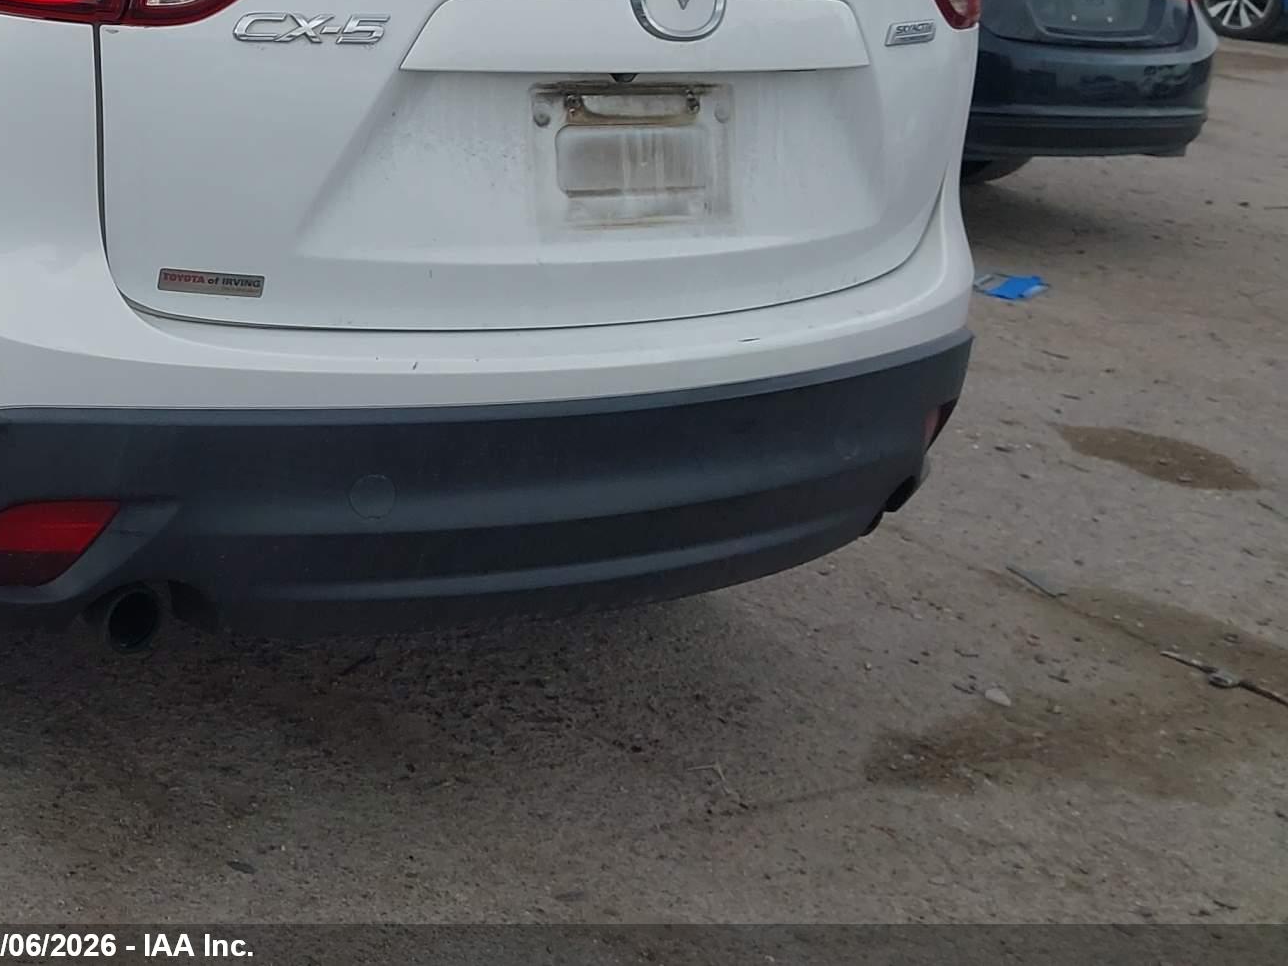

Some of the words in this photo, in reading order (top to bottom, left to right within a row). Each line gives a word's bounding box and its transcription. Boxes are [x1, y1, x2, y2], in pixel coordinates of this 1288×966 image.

[232, 10, 391, 45] CX-5
[162, 272, 206, 284] TOYOTA
[207, 276, 219, 285] of
[221, 277, 262, 289] IRVING
